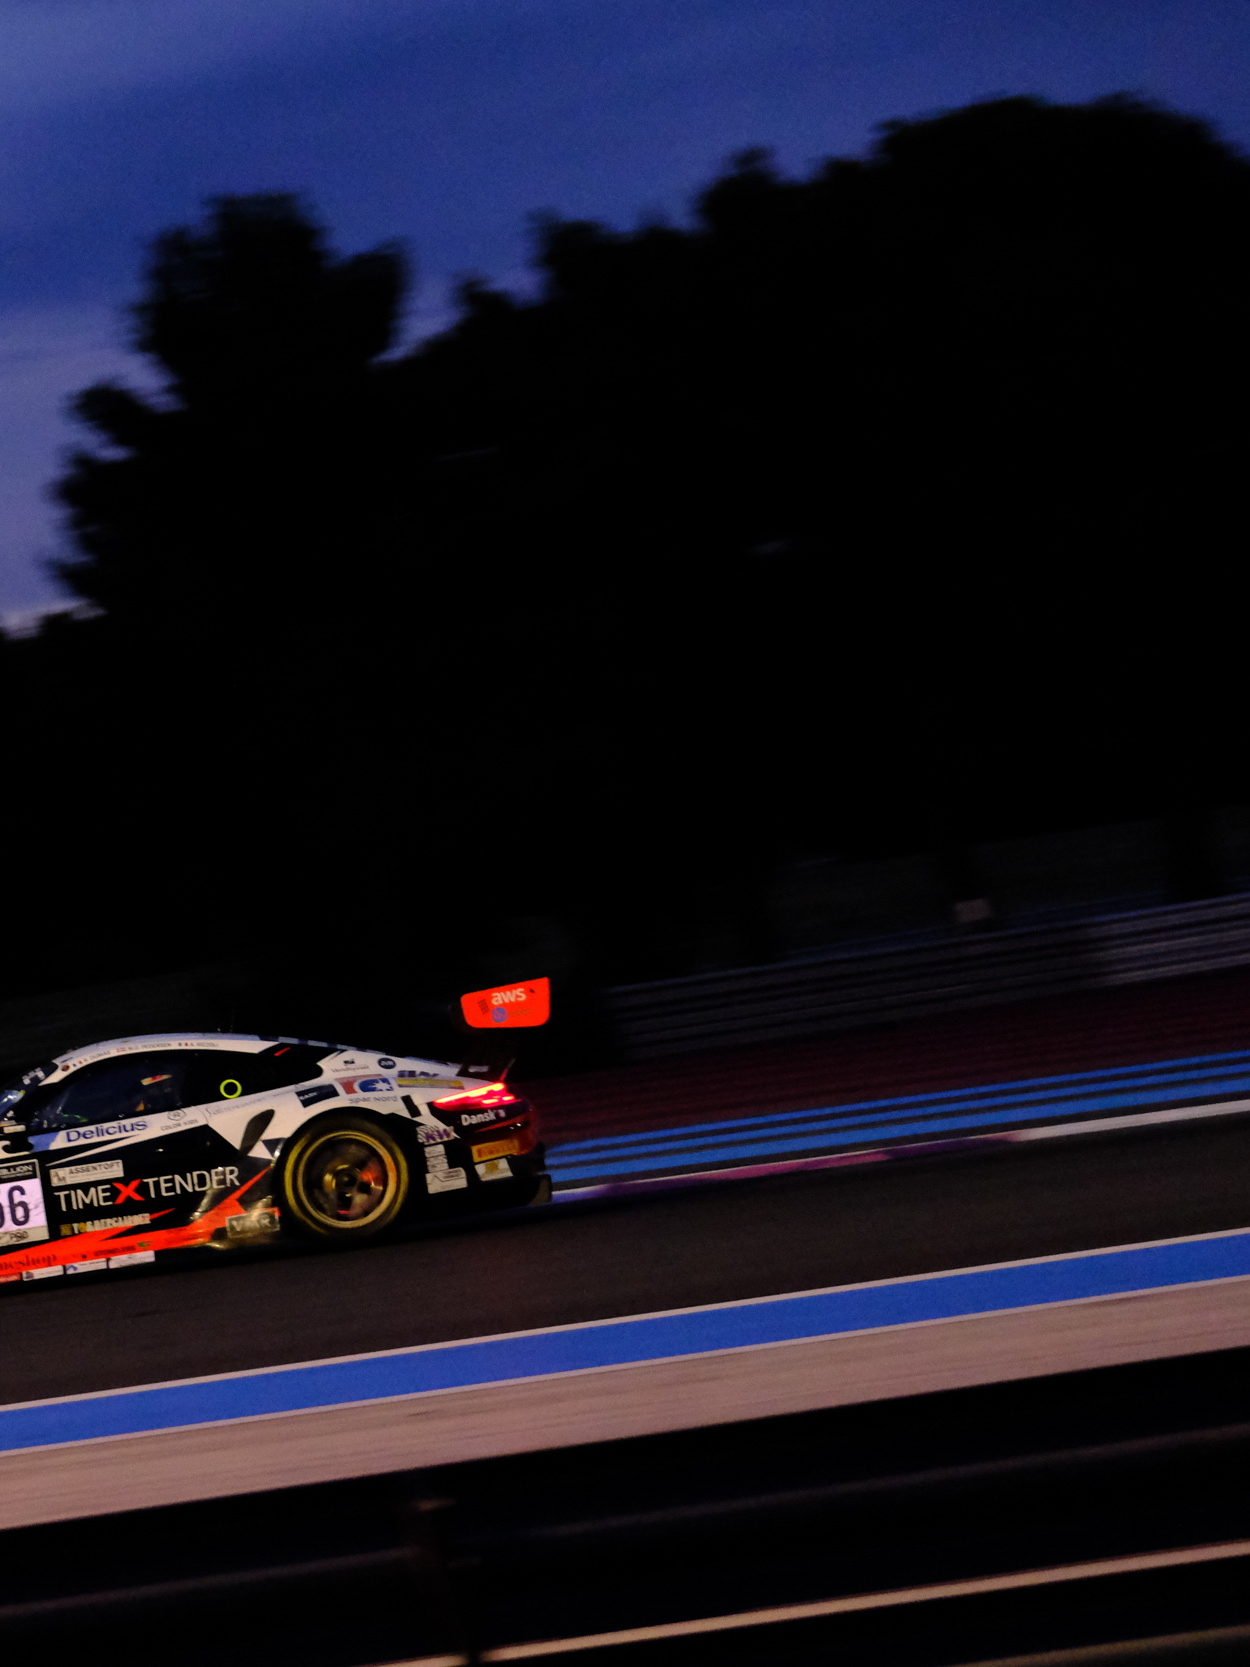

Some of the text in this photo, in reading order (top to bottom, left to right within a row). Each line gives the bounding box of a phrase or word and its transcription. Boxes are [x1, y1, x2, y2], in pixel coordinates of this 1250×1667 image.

[491, 988, 527, 1005] aws
[461, 1109, 497, 1126] Dansk
[66, 1121, 148, 1143] Delicius
[68, 1162, 121, 1176] ASSENTOFT
